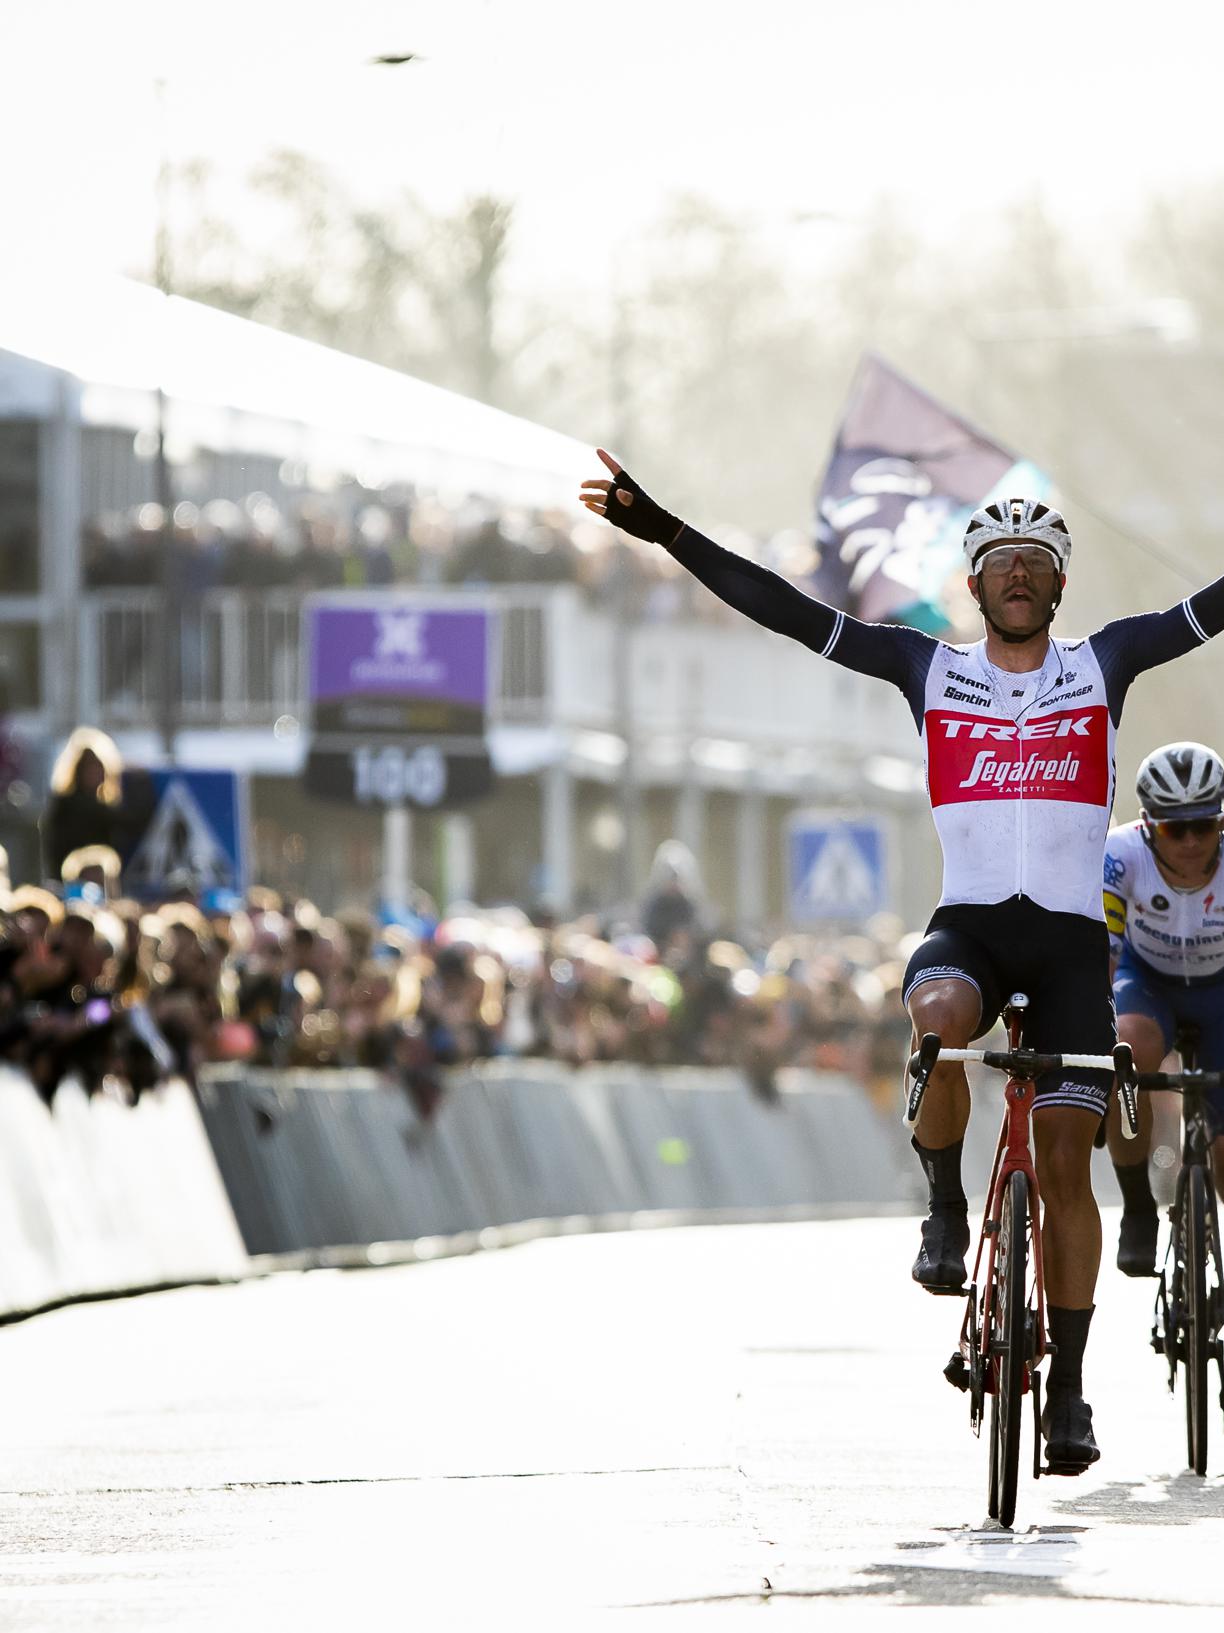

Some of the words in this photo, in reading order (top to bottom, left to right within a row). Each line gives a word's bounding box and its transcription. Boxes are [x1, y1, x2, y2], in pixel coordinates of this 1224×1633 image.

[942, 643, 970, 657] TREK
[945, 670, 991, 693] SRAM
[943, 686, 992, 708] Santini
[1038, 684, 1094, 709] BONTRAGER
[940, 716, 1093, 741] TREK
[354, 745, 446, 807] 100
[959, 750, 1080, 788] Segafredo
[914, 965, 964, 980] Santini
[1058, 1081, 1108, 1099] Santini
